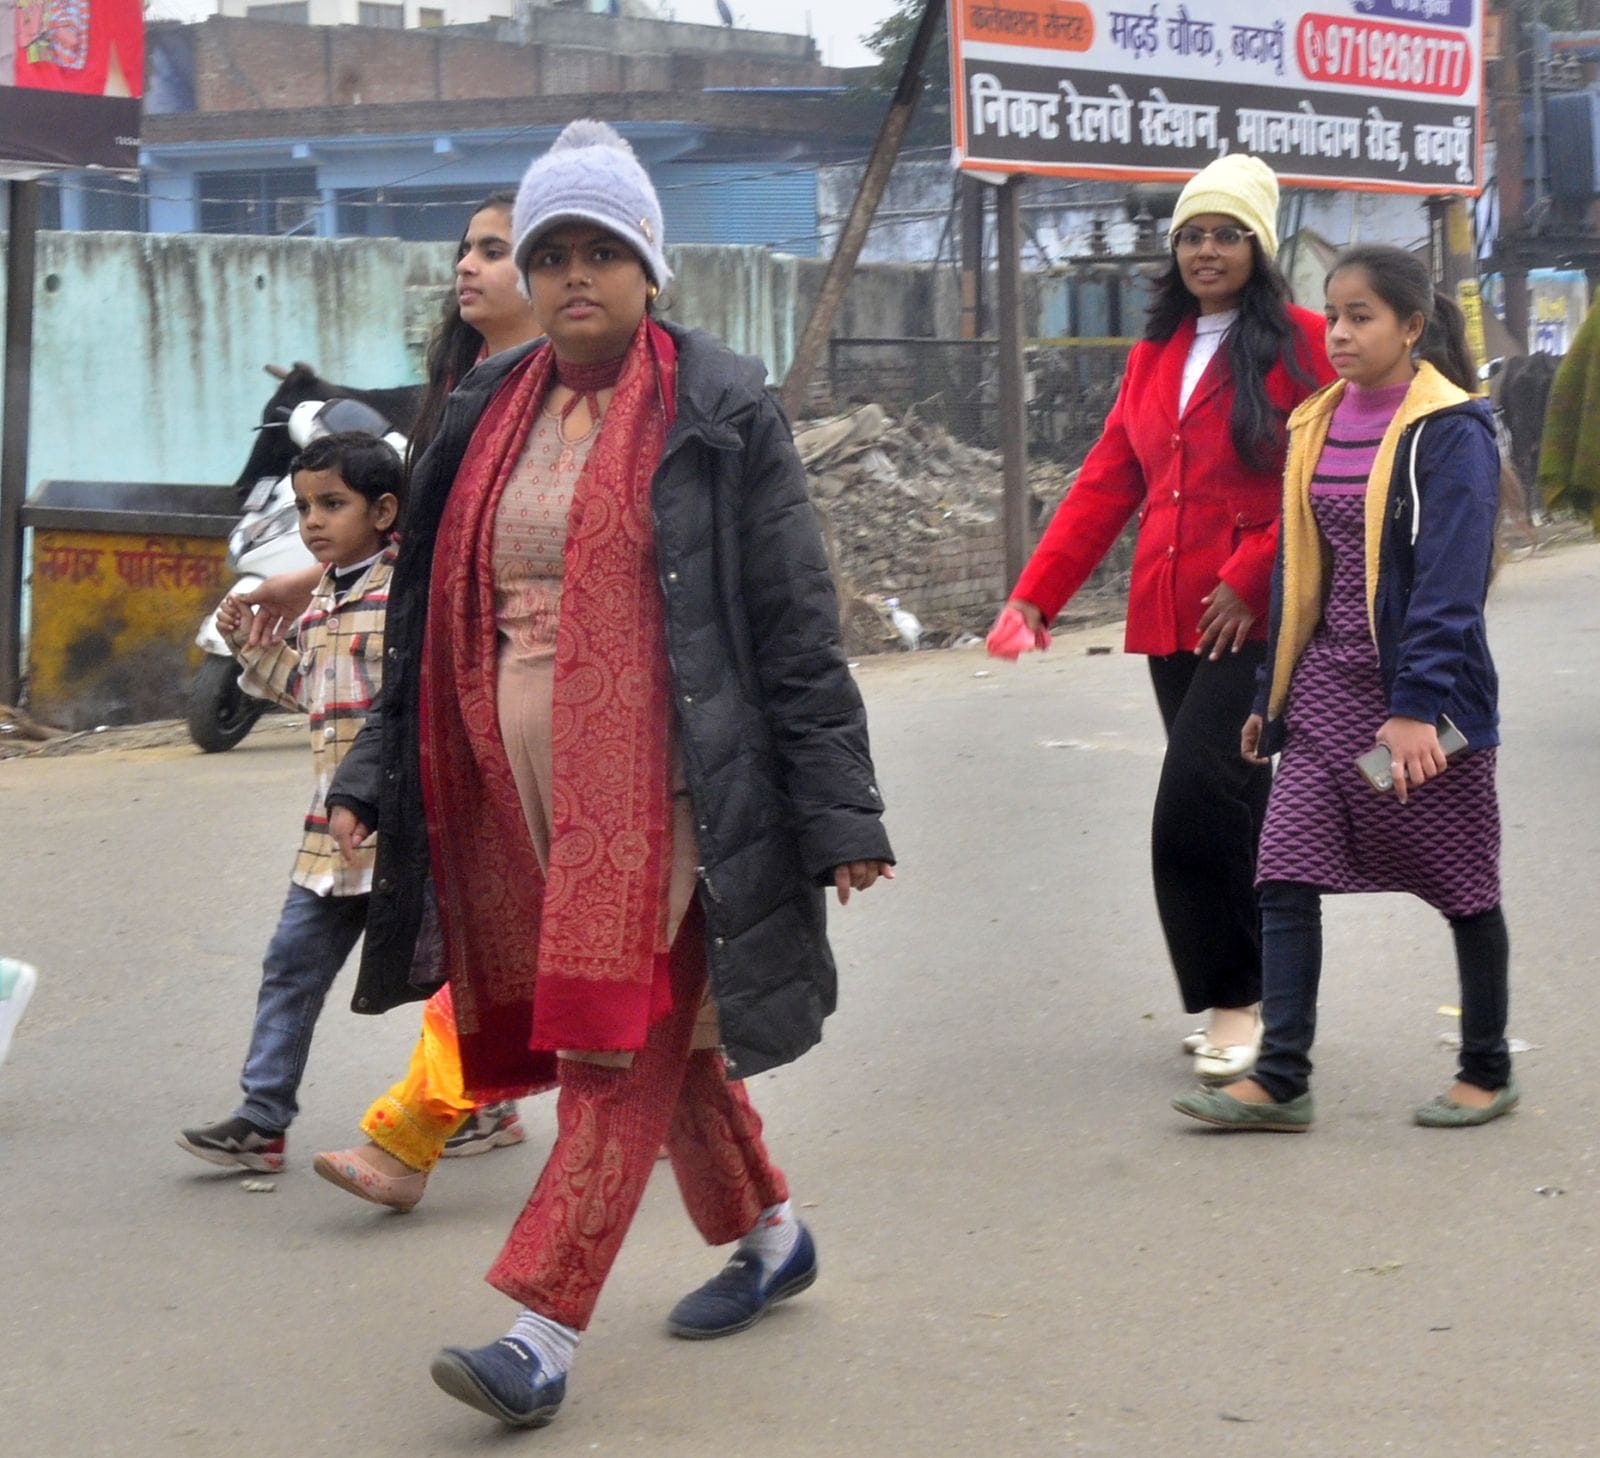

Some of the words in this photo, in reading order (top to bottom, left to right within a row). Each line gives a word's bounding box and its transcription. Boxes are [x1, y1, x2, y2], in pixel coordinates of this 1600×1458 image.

[1324, 24, 1466, 88] 9719268777
[970, 72, 1061, 140] निकट
[1059, 79, 1134, 145] रेलवे
[1235, 100, 1363, 159] मालगोदाम
[1413, 115, 1473, 183] बदायूँ
